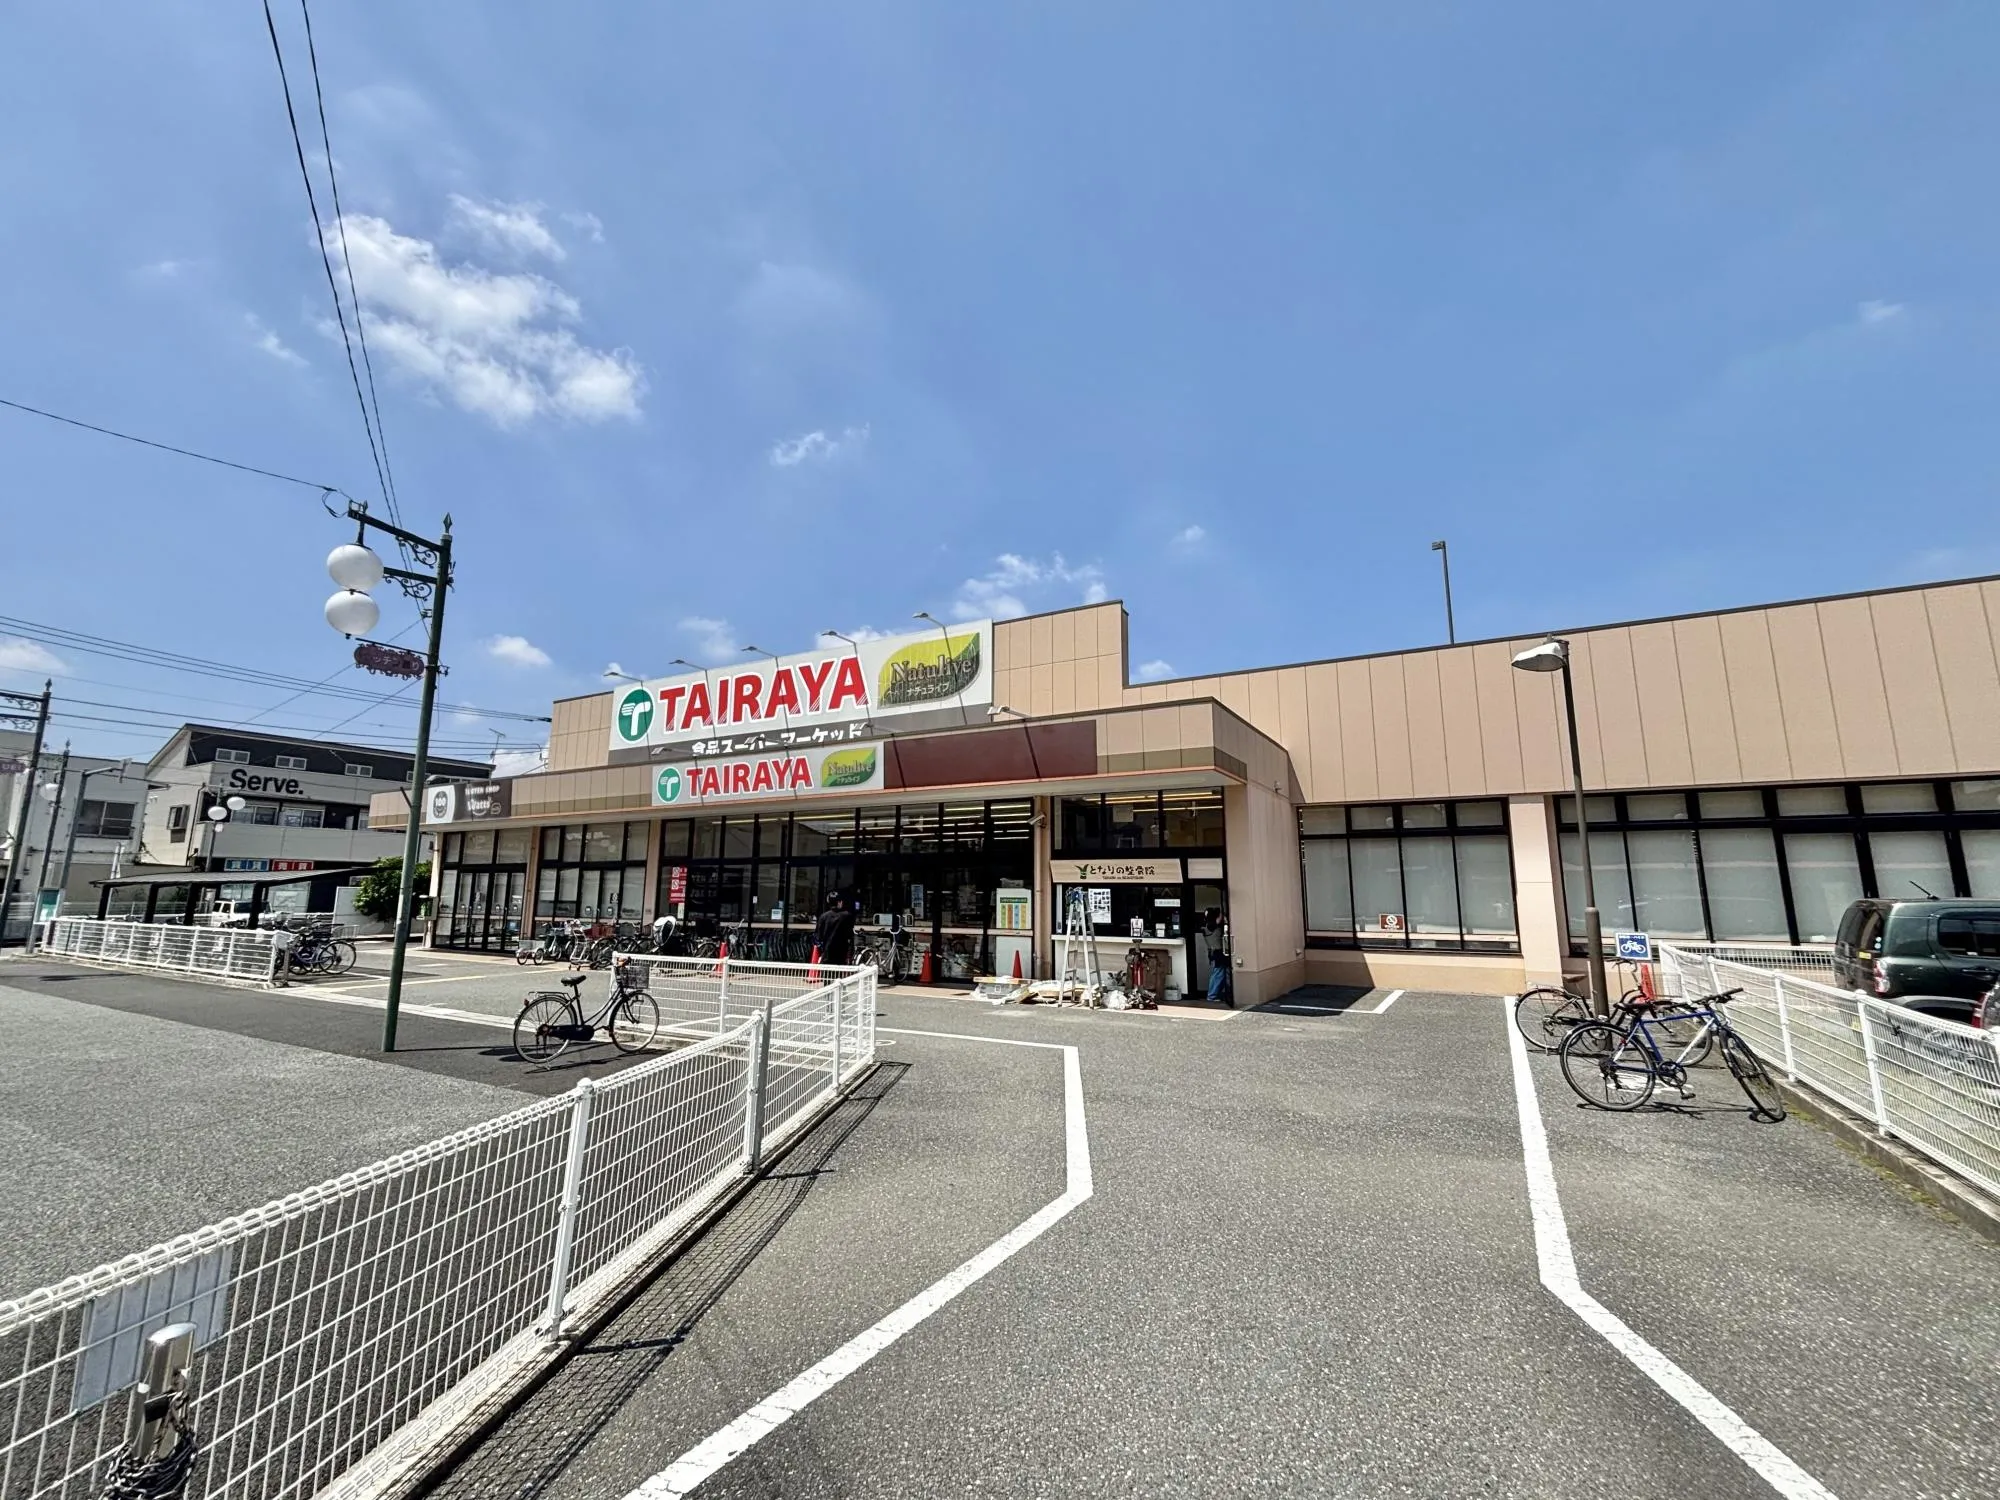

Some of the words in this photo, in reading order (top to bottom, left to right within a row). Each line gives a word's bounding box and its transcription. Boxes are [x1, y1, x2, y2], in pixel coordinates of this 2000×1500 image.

[890, 655, 973, 684] Natulive
[659, 657, 869, 732] TAIRAYA
[229, 769, 304, 795] Serve.
[687, 757, 813, 797] TAIRAYA
[1089, 865, 1155, 876] となりの整骨院
